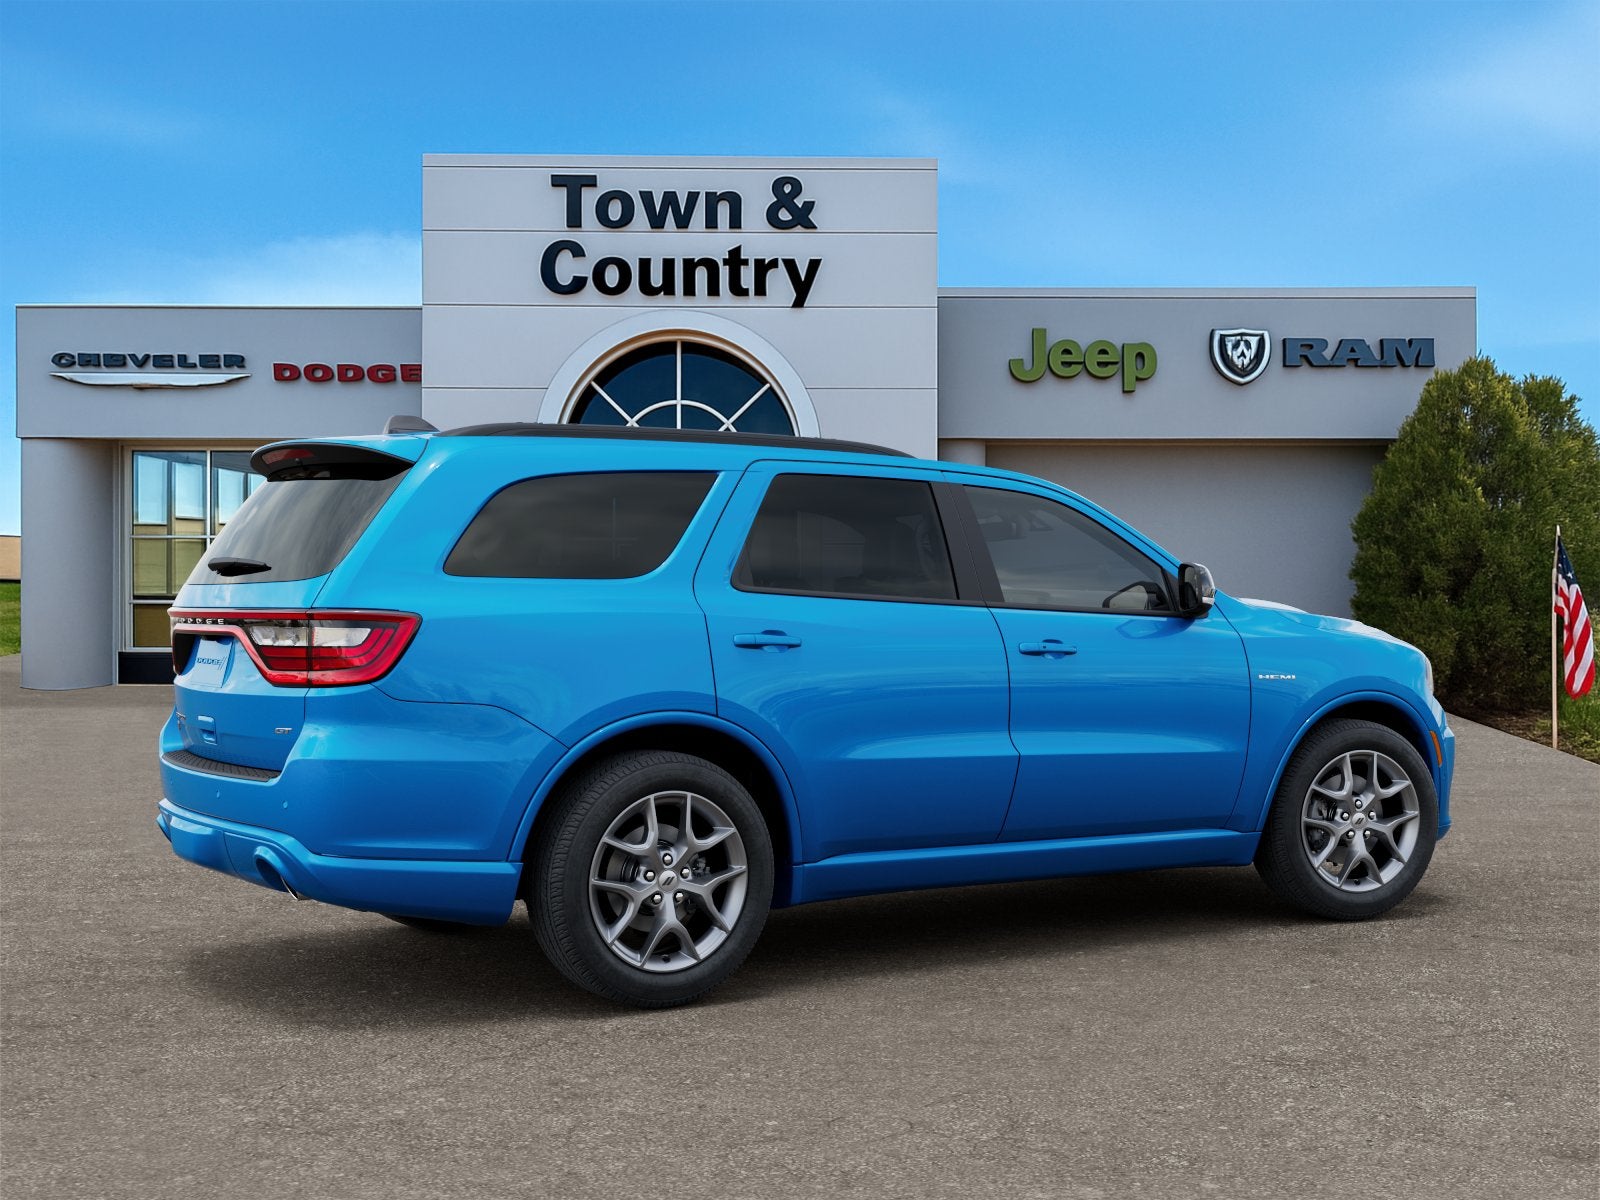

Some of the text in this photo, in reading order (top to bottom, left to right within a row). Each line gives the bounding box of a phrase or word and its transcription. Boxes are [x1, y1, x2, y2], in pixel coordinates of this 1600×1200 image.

[550, 174, 818, 230] Town &
[540, 239, 822, 309] Country
[272, 363, 422, 383] DODGE
[1008, 328, 1158, 393] Jeep
[1282, 337, 1436, 368] RAM
